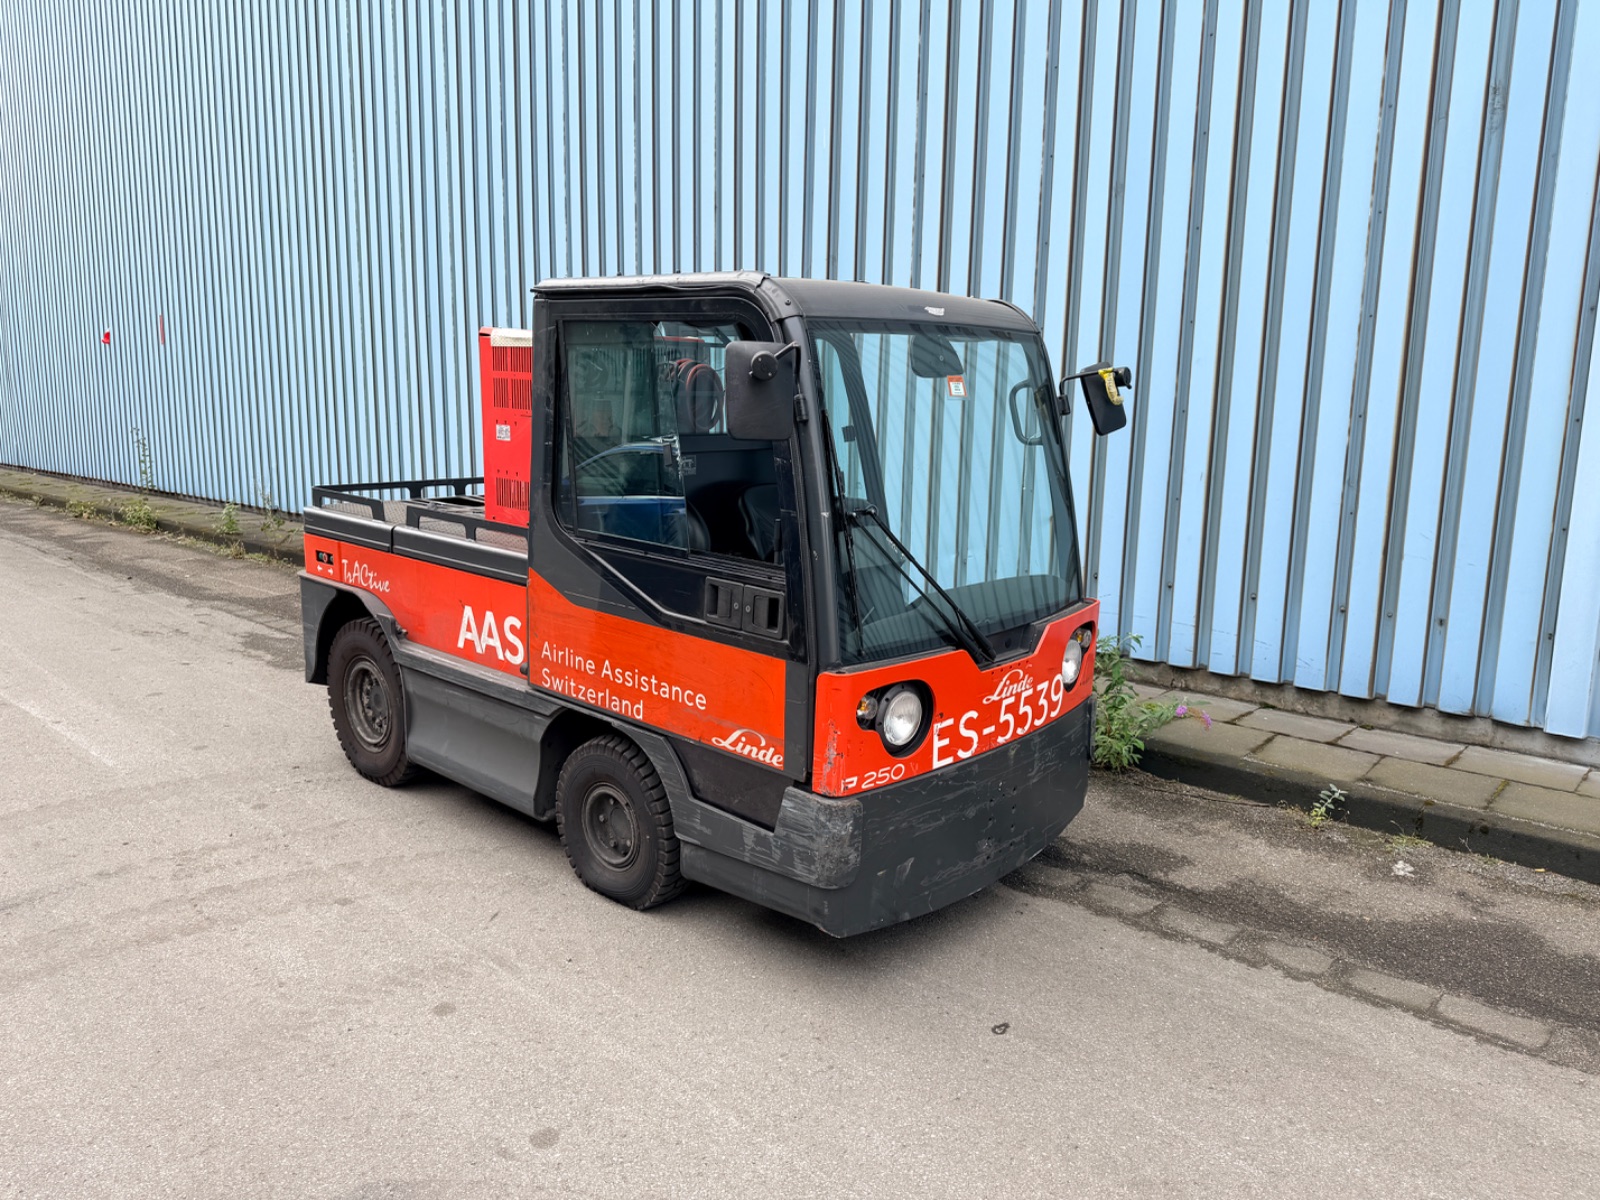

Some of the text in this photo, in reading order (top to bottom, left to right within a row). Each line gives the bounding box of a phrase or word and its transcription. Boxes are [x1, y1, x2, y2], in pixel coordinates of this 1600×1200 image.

[457, 605, 525, 666] AAS
[541, 641, 708, 711] Airline Assistance
[541, 668, 644, 720] Switzerland
[982, 668, 1034, 705] Linde
[711, 728, 784, 767] Linde
[932, 673, 1065, 770] ES-5539
[861, 763, 905, 789] 250
